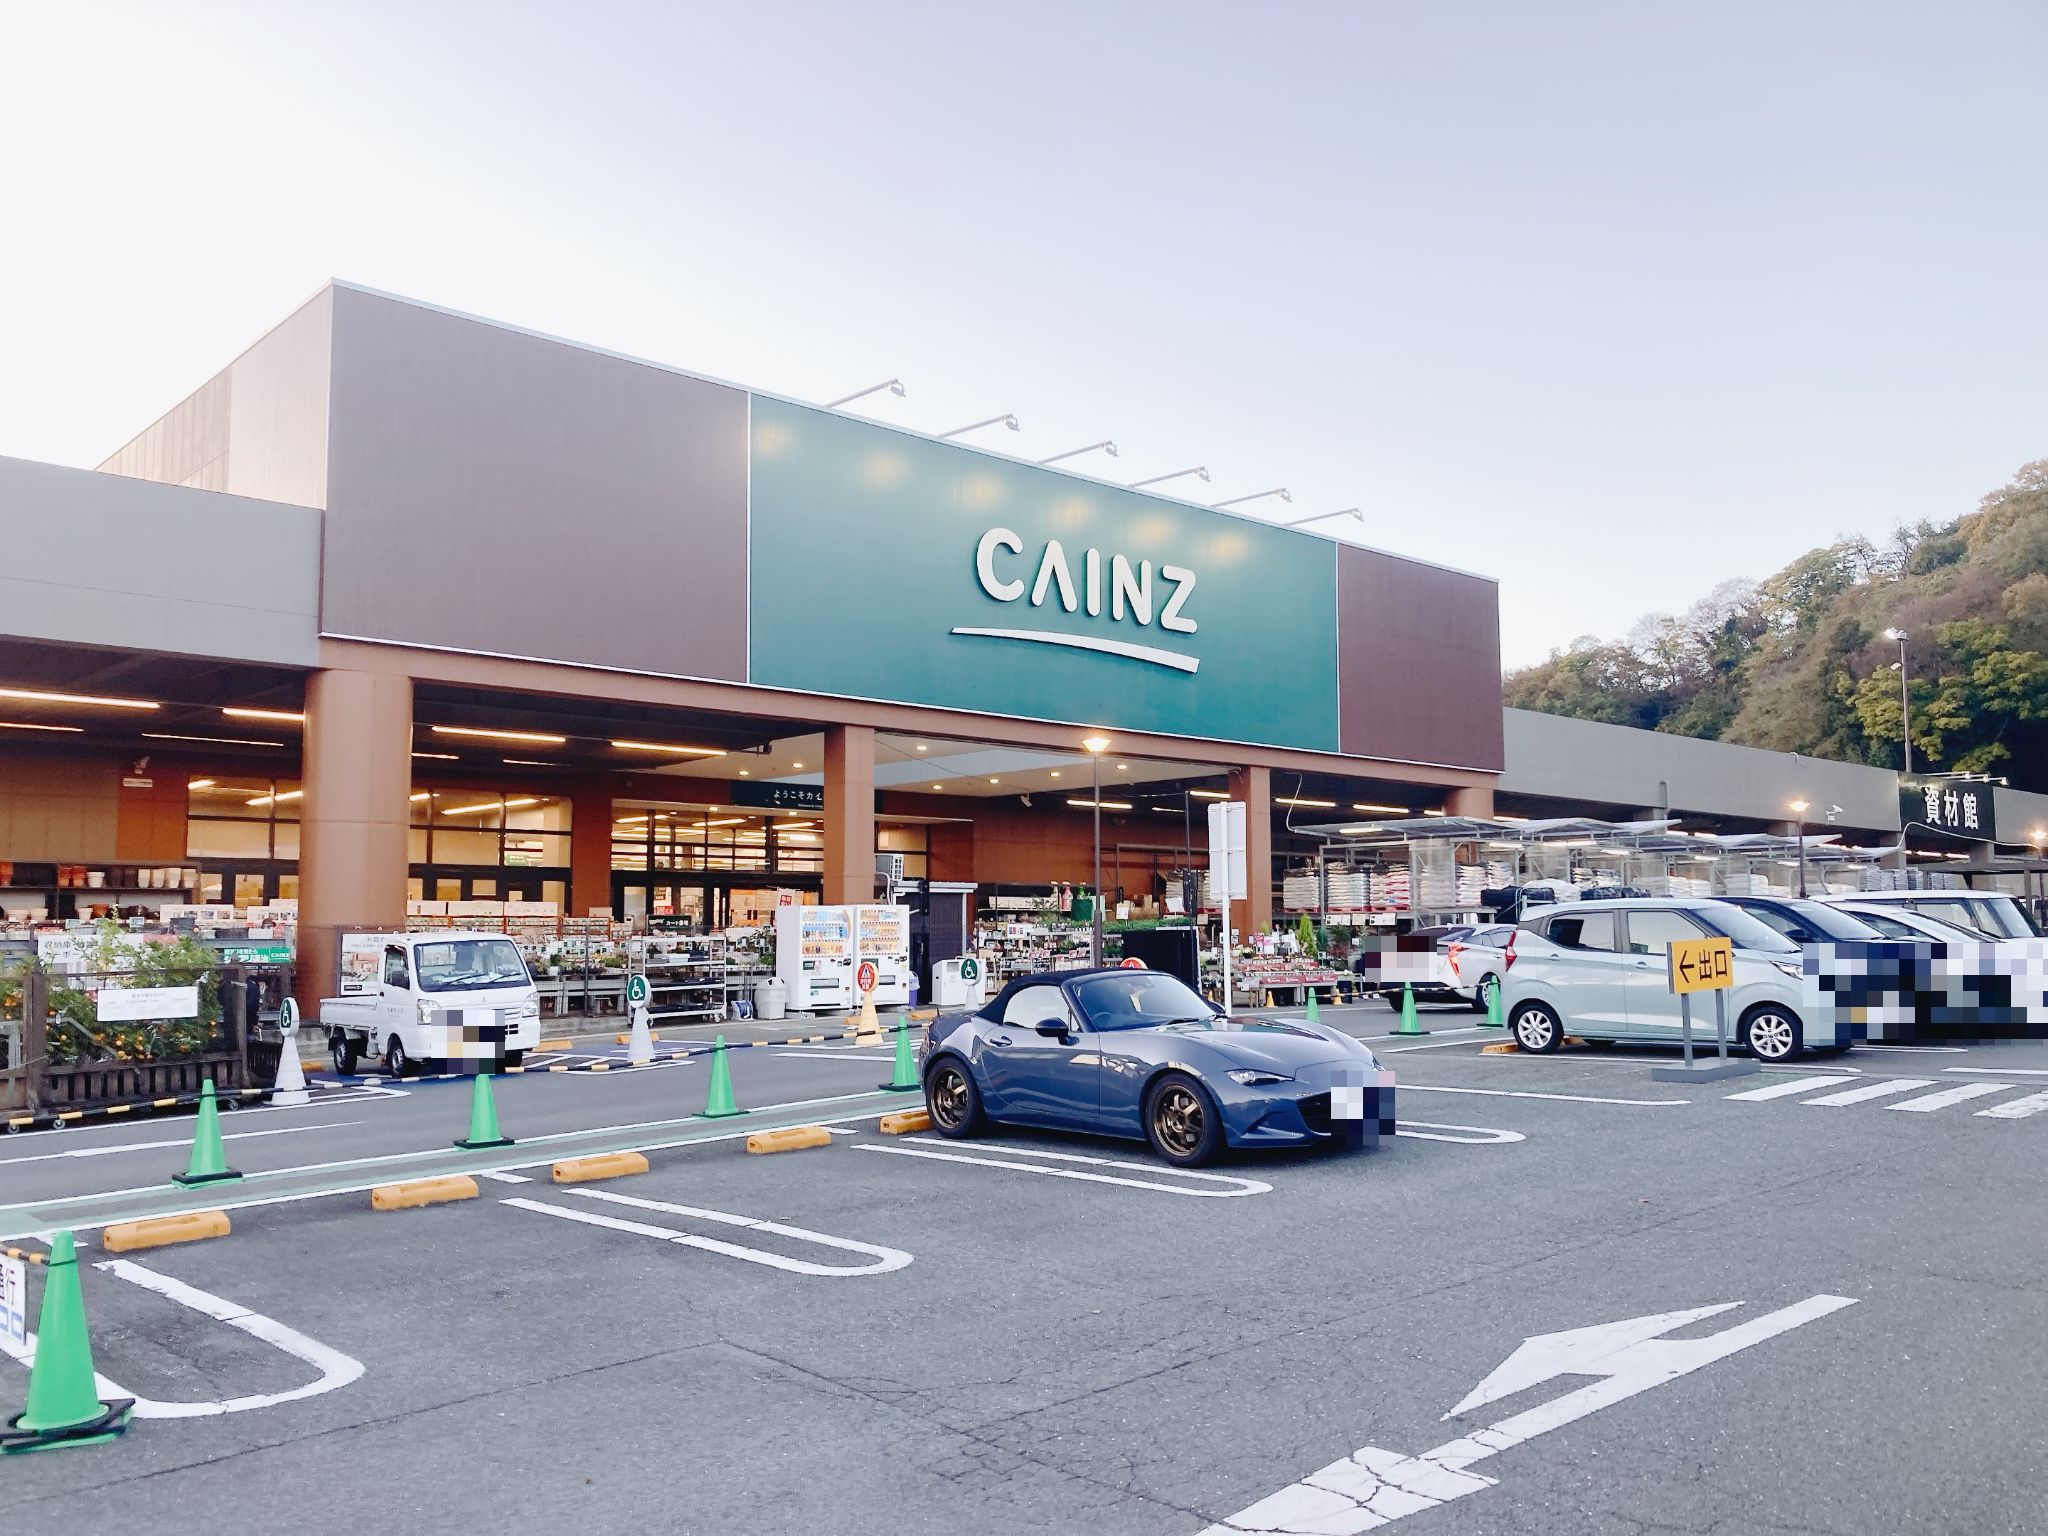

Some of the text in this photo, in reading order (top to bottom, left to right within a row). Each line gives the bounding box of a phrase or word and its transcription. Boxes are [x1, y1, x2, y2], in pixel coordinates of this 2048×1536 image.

[976, 527, 1198, 633] CAINZ
[1924, 787, 1979, 829] 資材館
[1698, 949, 1728, 981] 出口
